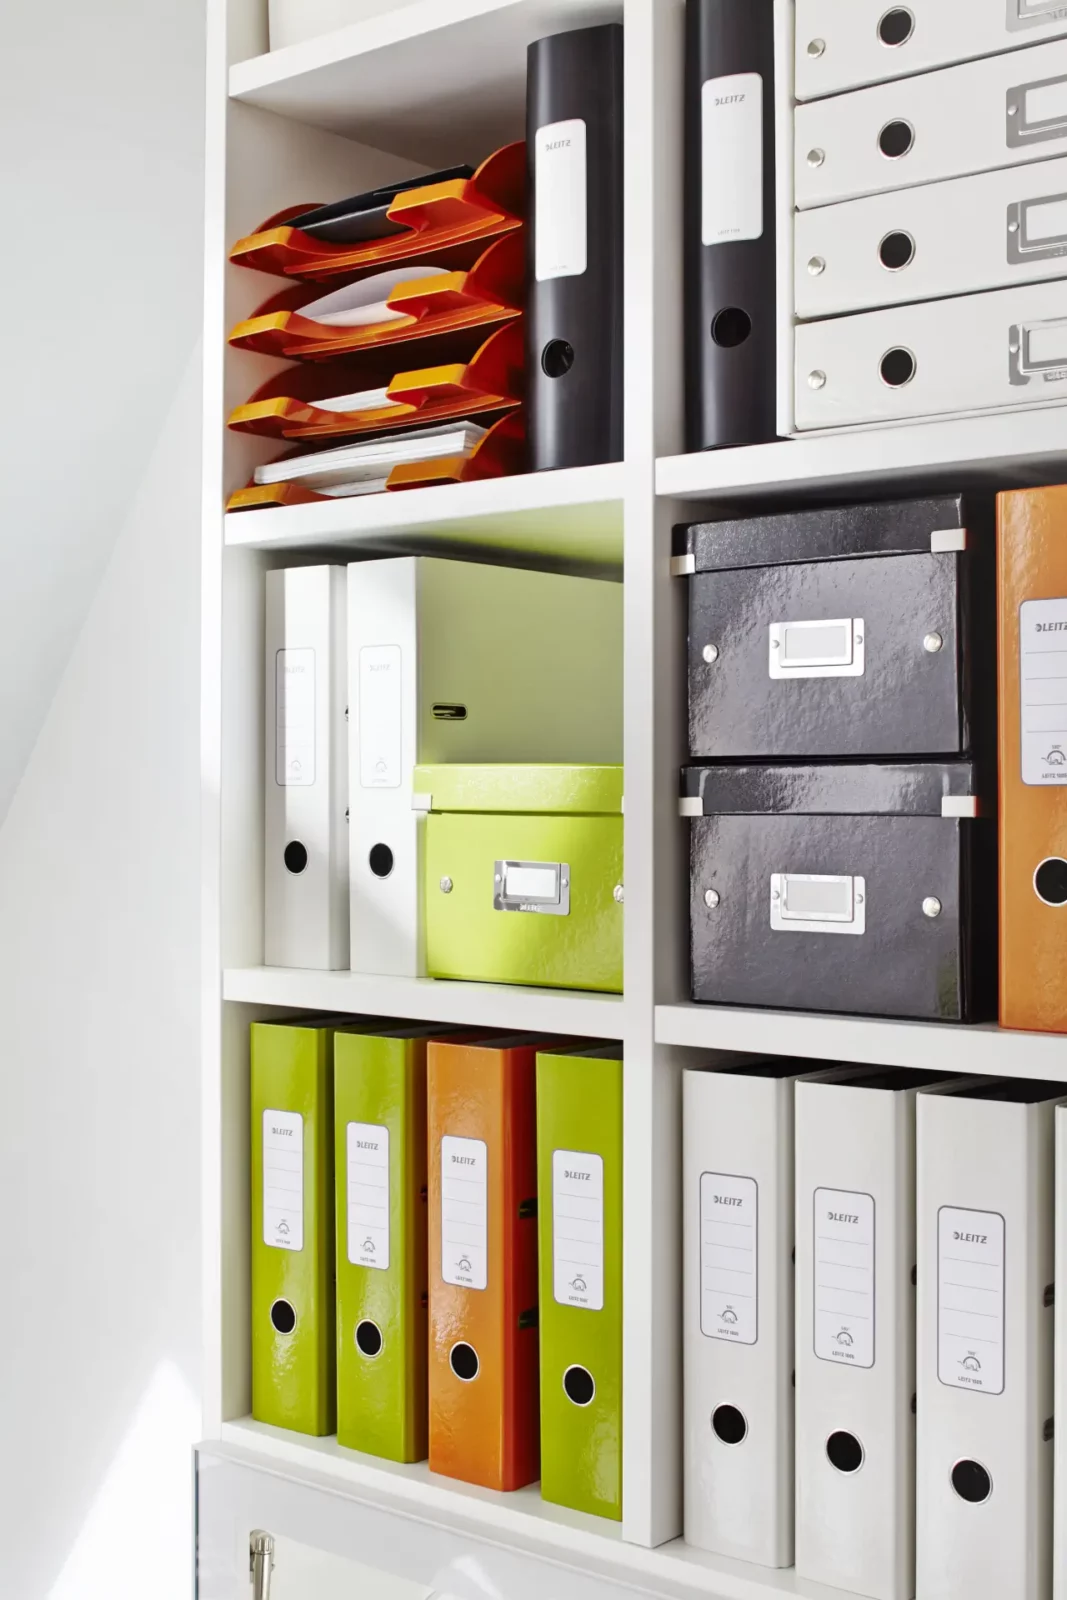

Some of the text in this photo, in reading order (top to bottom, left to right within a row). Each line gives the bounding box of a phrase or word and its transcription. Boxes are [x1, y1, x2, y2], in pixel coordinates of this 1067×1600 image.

[720, 94, 745, 105] LEITZ
[549, 139, 571, 150] LEITZ
[276, 1128, 293, 1137] LEITZ
[360, 1141, 379, 1151] LEITZ
[456, 1156, 476, 1166] LEITZ
[569, 1171, 591, 1181] LEITZ
[719, 1196, 743, 1207] LEITZ
[833, 1212, 859, 1224] LEITZ
[960, 1232, 988, 1244] LEITZ
